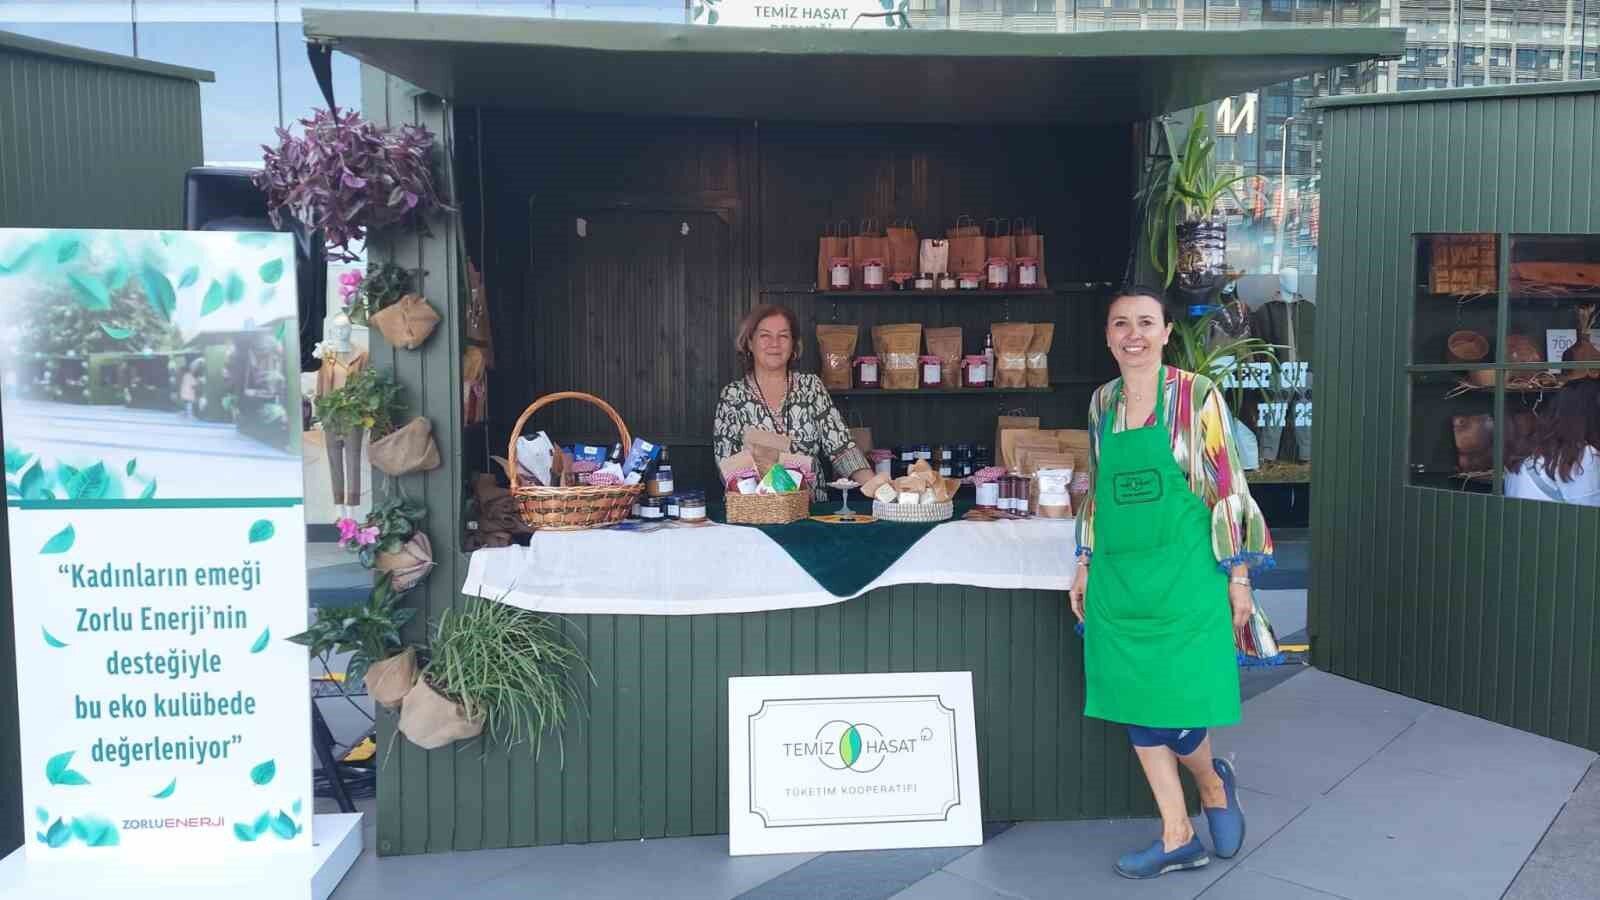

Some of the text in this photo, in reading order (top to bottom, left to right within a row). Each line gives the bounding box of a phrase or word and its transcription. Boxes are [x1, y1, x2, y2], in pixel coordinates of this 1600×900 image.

[754, 4, 848, 20] TEMİZ HASAT
[58, 560, 261, 591] “Kadınların emeği
[75, 606, 133, 632] Zorlu
[106, 648, 221, 679] desteğiyle
[75, 690, 256, 719] bu eko kulübede
[91, 734, 242, 767] değerleniyor”
[866, 738, 918, 754] HASAT
